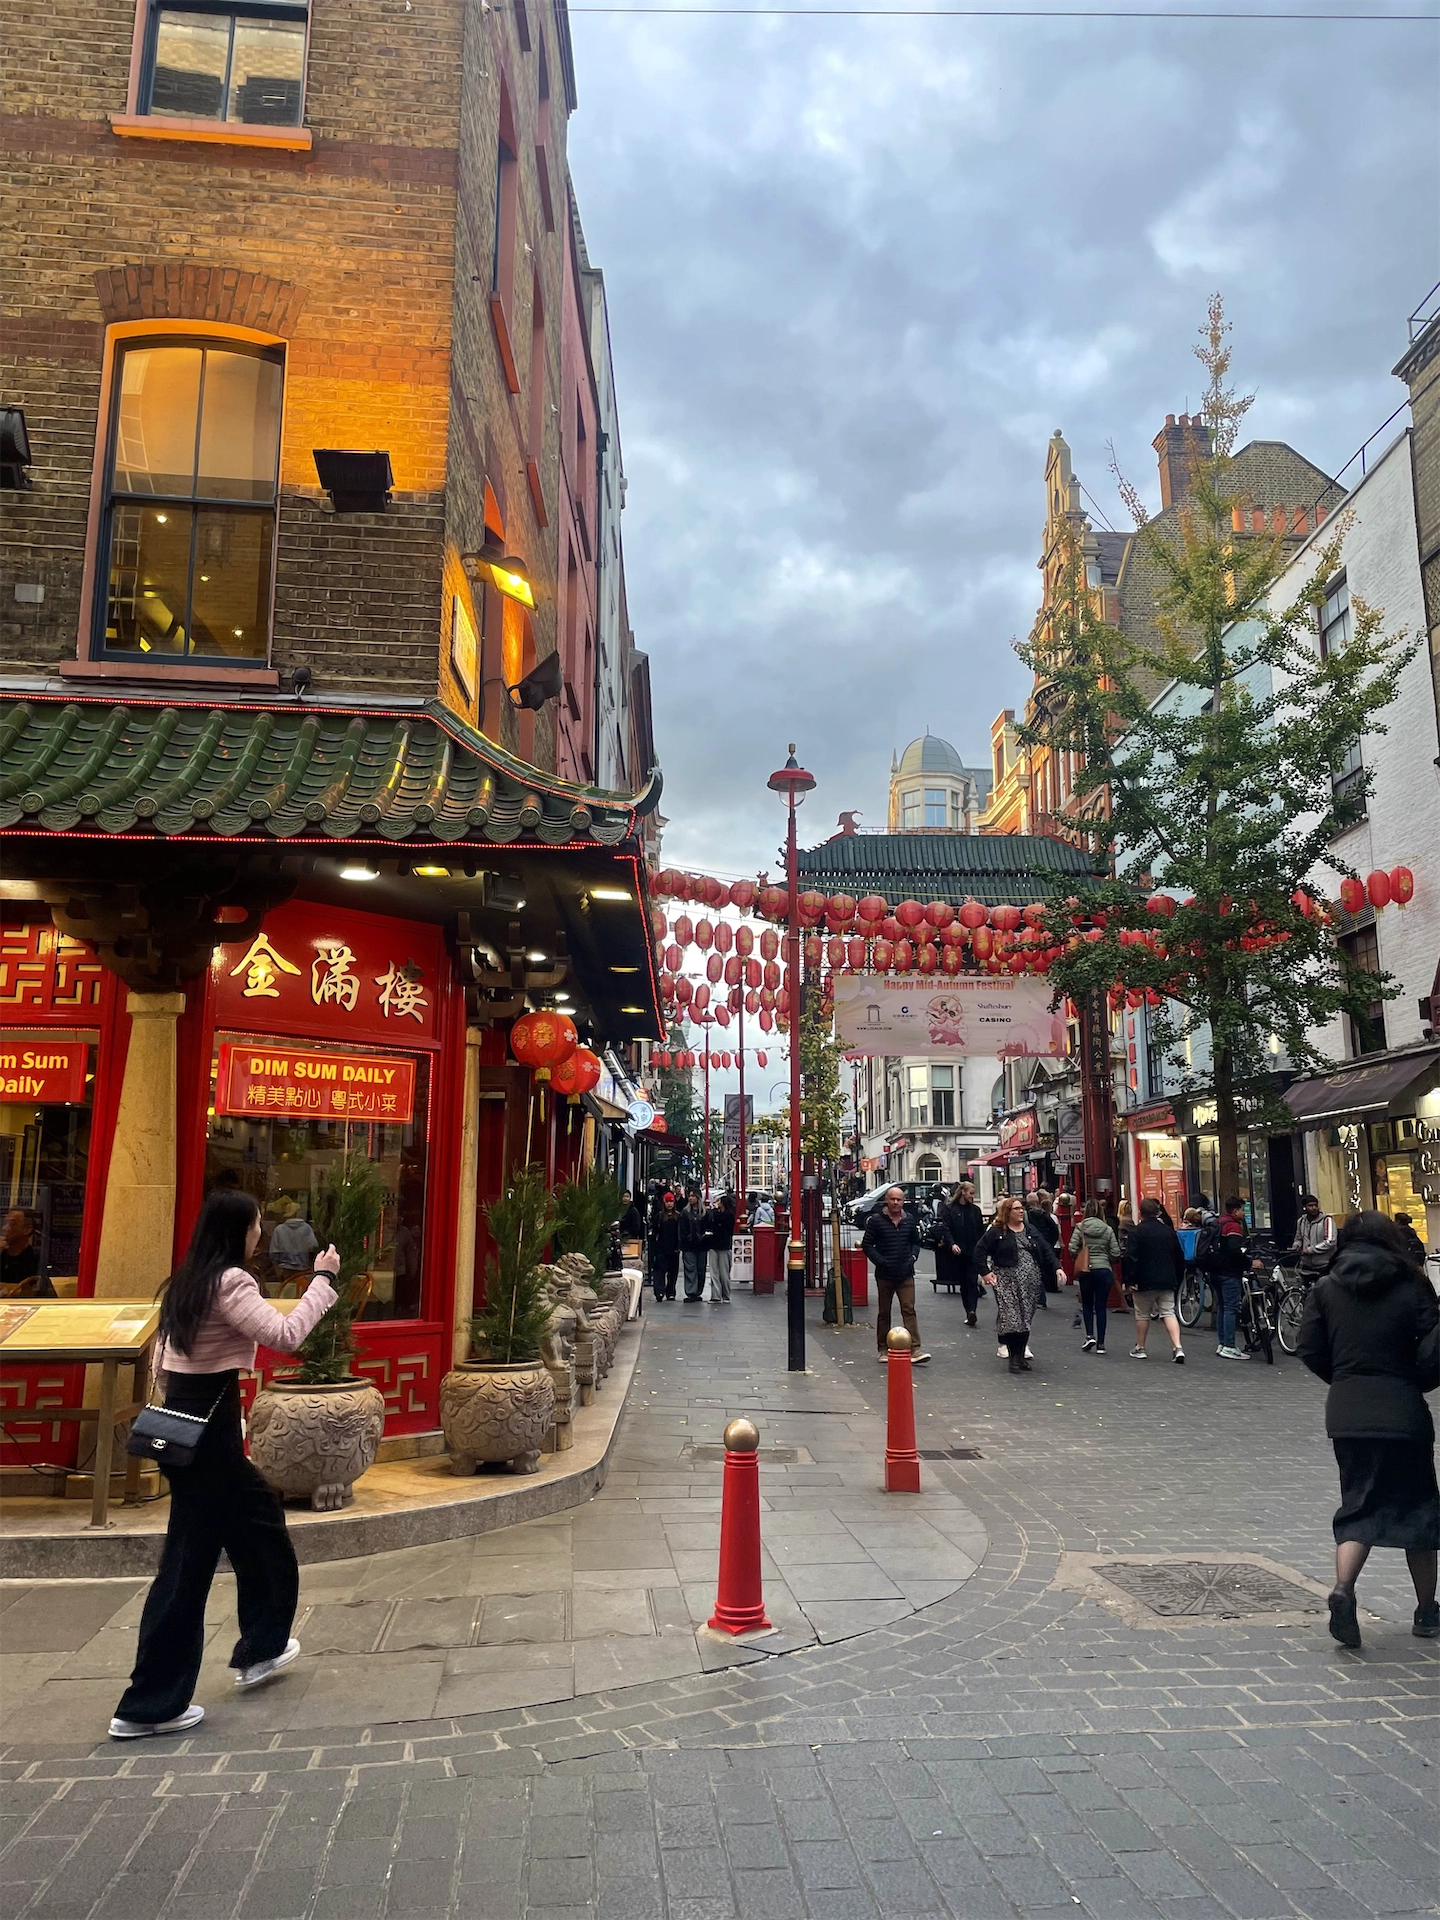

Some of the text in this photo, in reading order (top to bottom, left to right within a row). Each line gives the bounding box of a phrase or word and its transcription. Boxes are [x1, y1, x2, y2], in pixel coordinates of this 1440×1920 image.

[229, 932, 429, 1024] 金滿樓
[884, 980, 1015, 991] Happy Mid-Autumn Festival
[21, 1051, 69, 1069] Sum
[250, 1058, 396, 1084] DIM SUM DAILY
[247, 1084, 321, 1108] 精美點心
